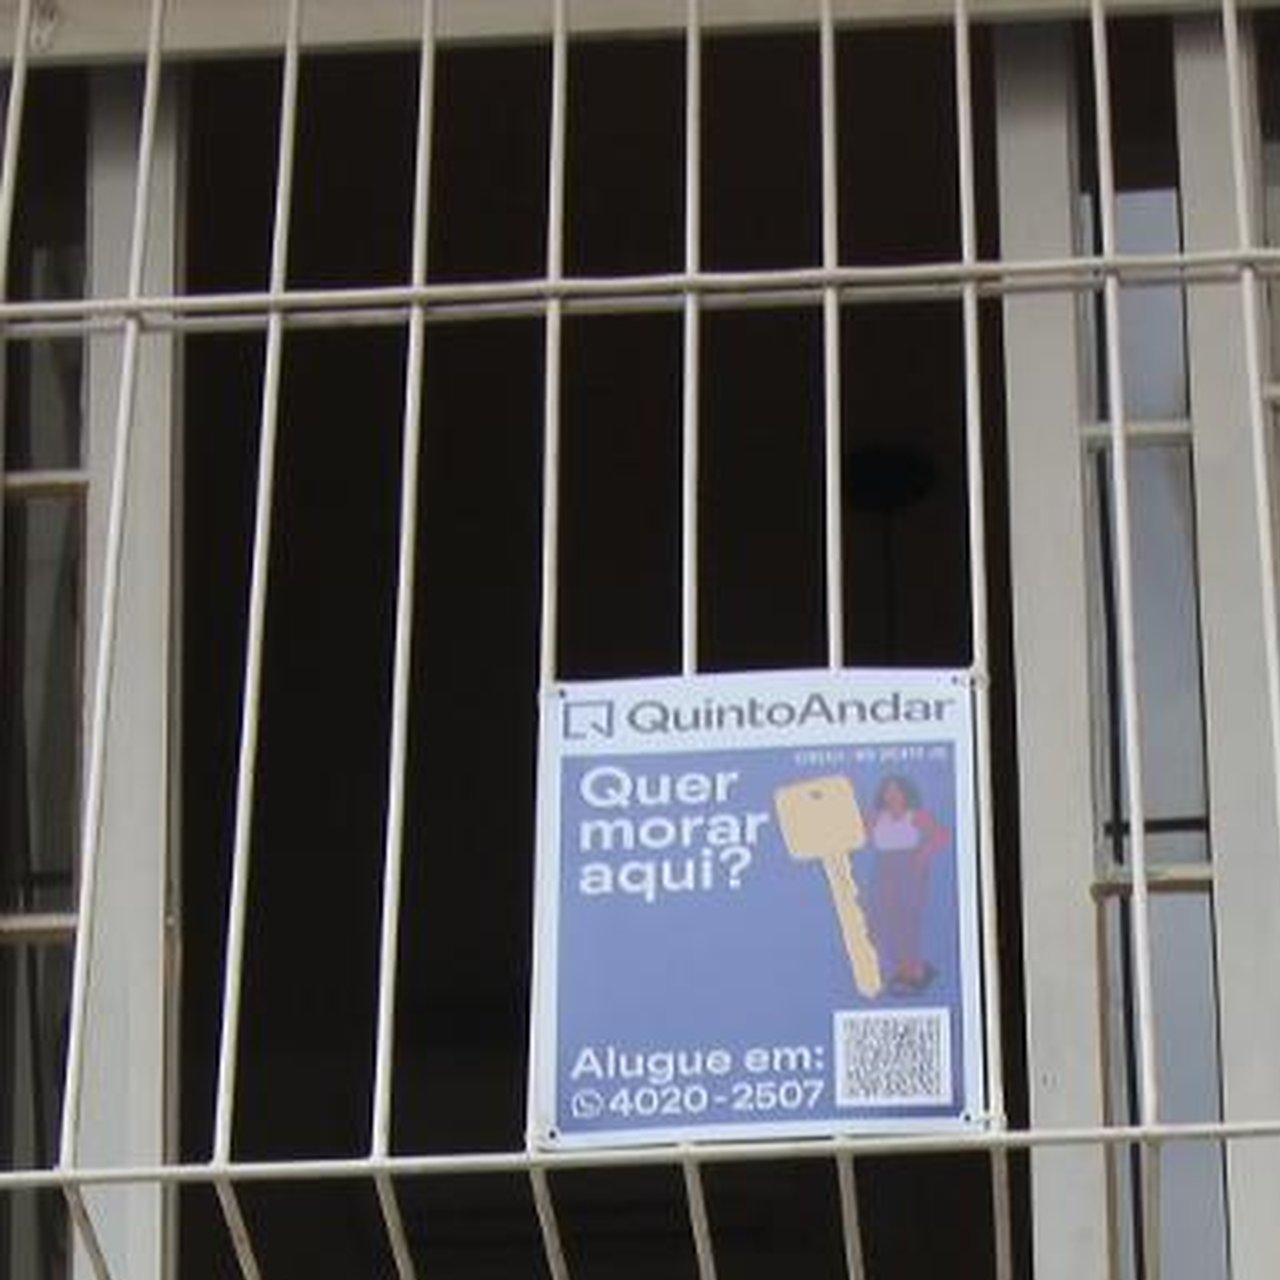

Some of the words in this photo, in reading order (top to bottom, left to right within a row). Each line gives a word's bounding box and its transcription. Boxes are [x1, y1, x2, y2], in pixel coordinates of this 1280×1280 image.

[626, 693, 957, 733] QuintoAndar
[579, 767, 740, 808] Quer
[579, 812, 769, 850] morar
[579, 846, 752, 902] aqui?
[571, 1046, 732, 1085] Alugue
[745, 1045, 825, 1073] em:
